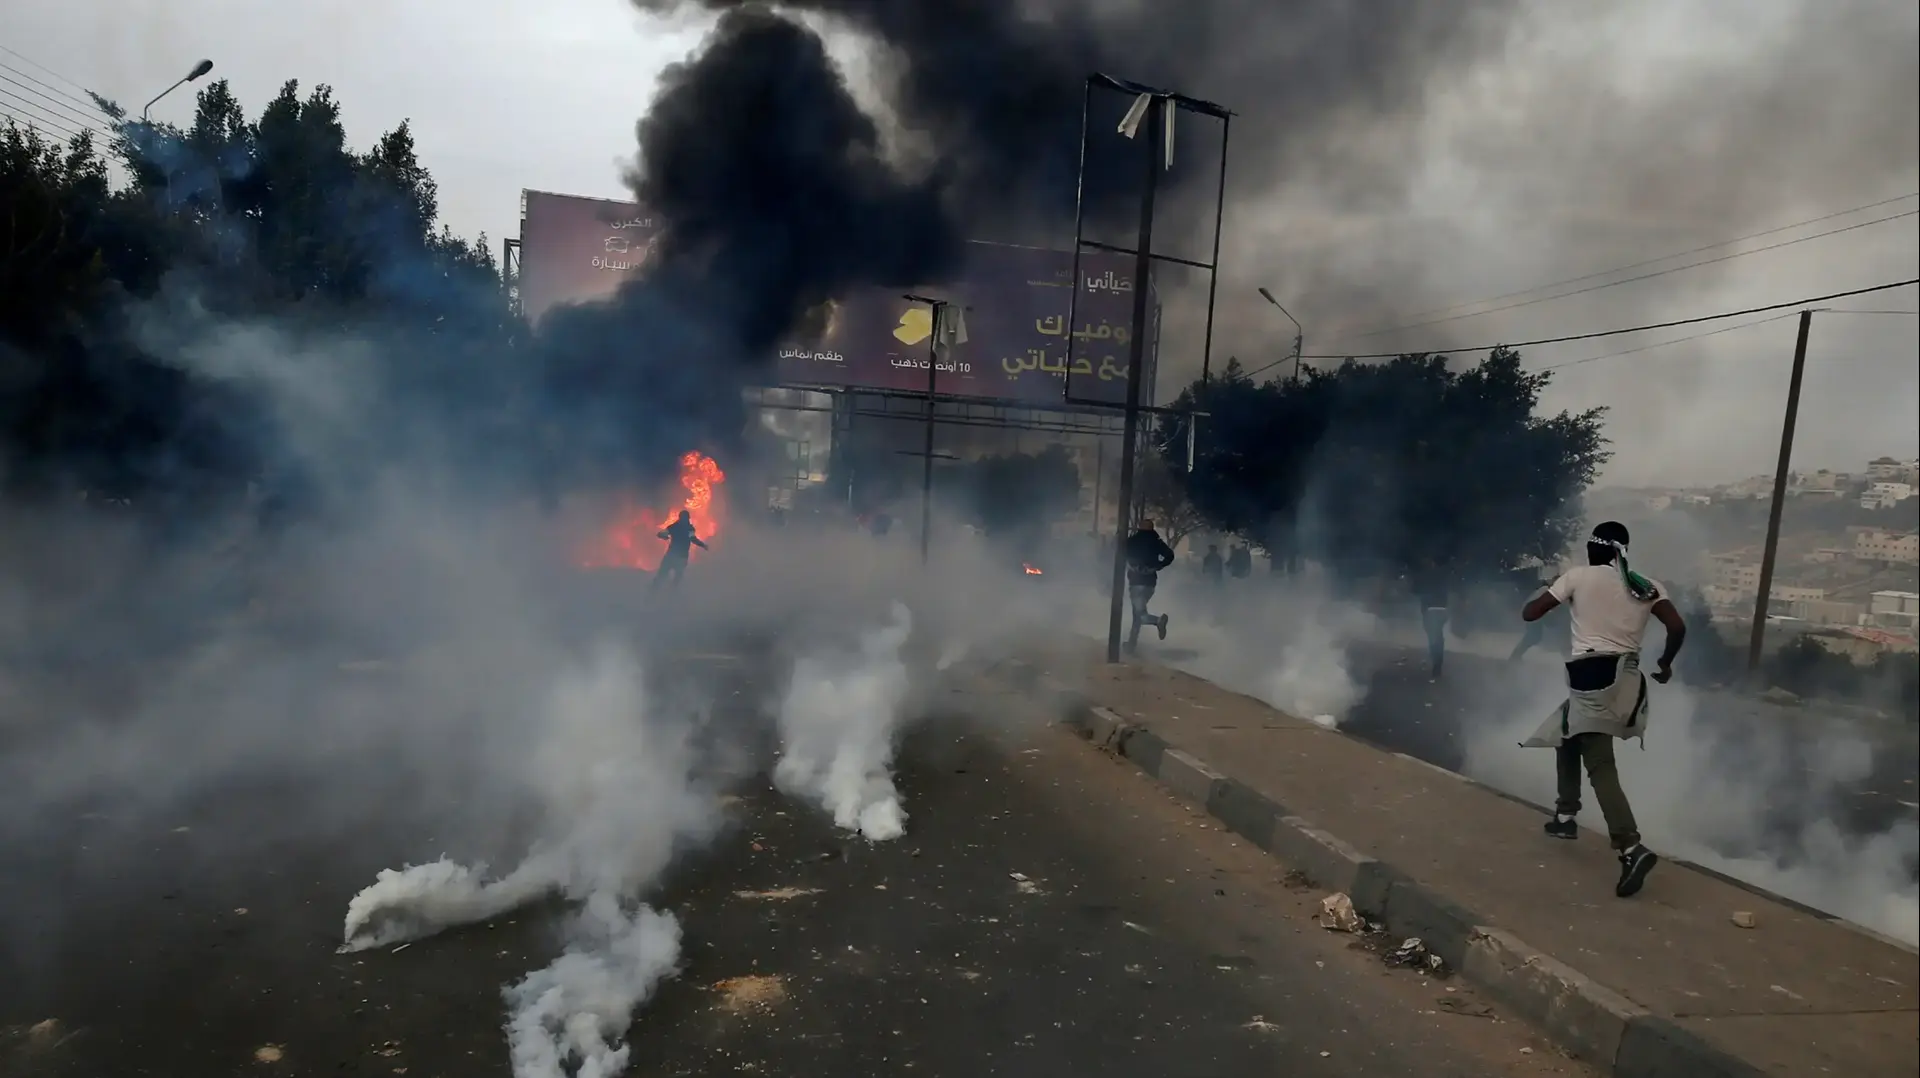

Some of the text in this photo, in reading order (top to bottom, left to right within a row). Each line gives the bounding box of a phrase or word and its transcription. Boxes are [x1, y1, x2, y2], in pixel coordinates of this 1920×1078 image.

[591, 256, 630, 272] سيارة
[779, 348, 844, 362] طقم الماس
[890, 358, 971, 373] 10 أونصت ذهب
